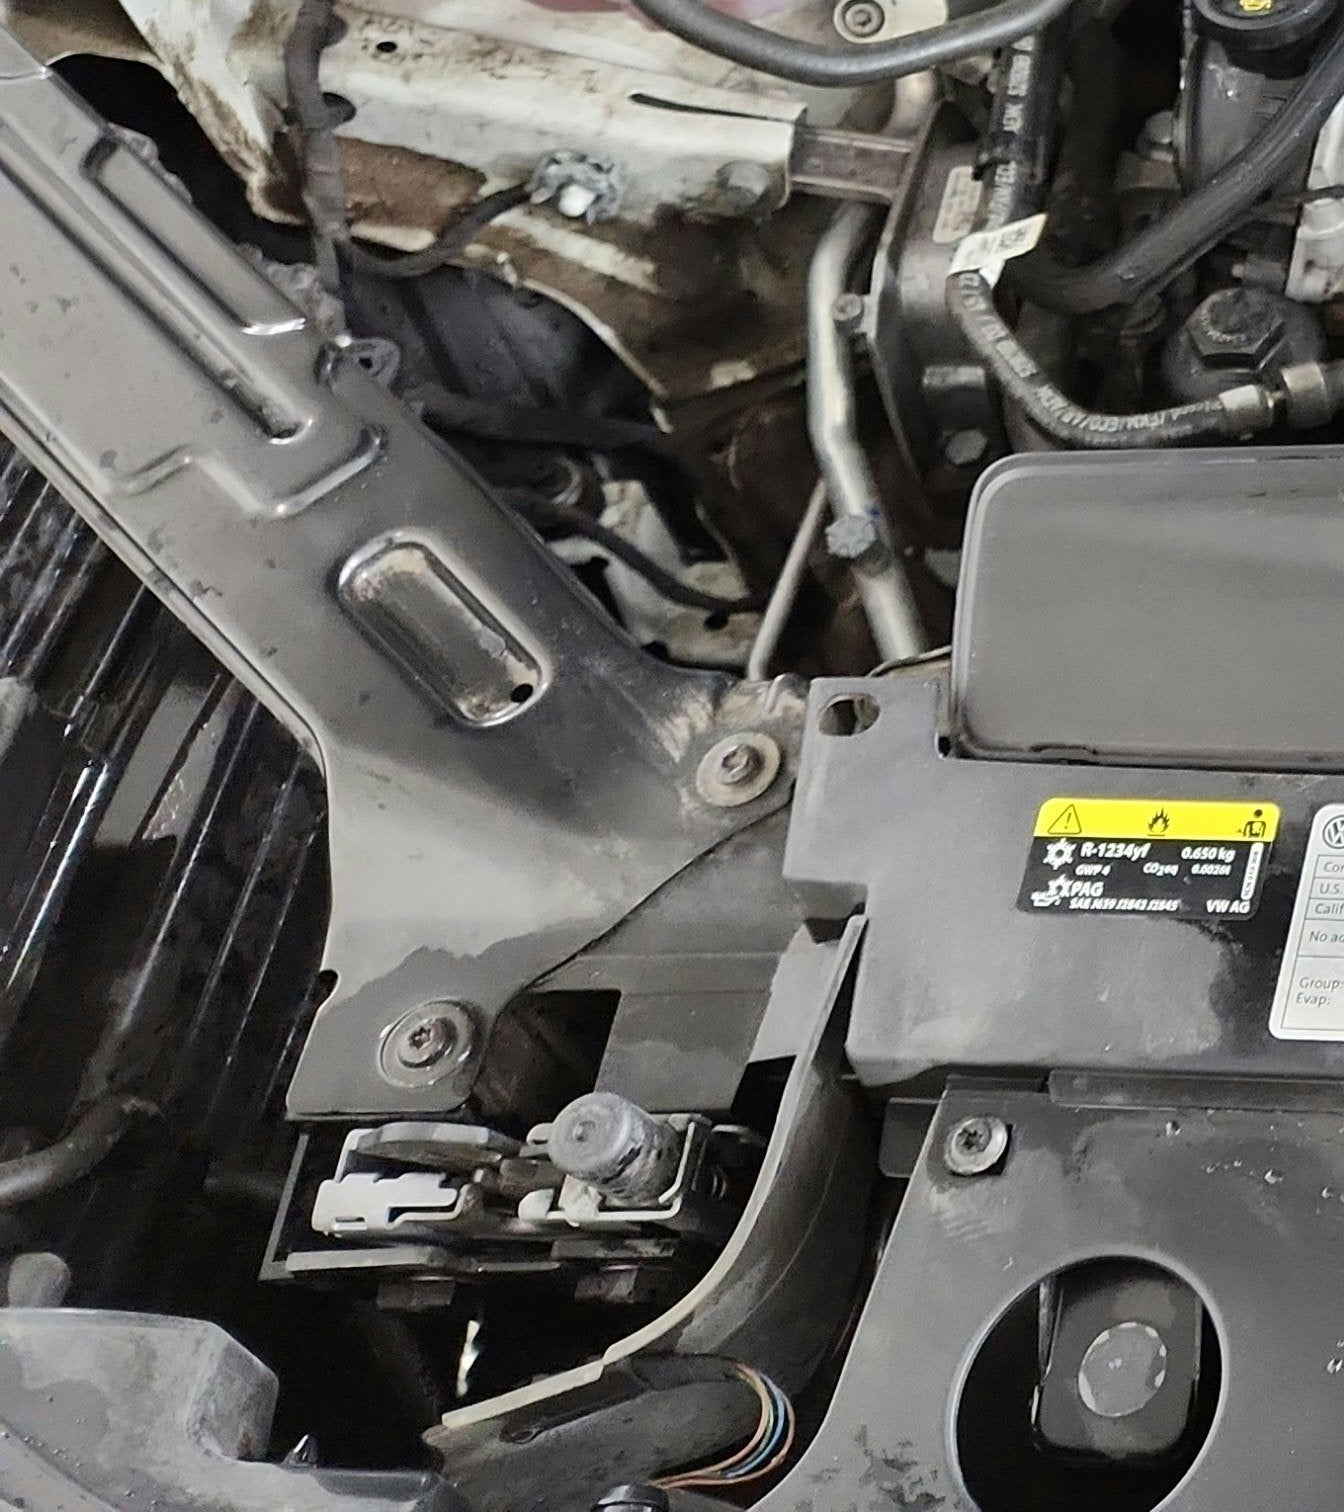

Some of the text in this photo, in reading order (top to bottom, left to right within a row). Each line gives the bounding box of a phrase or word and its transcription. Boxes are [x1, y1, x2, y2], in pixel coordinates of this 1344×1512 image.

[1181, 846, 1236, 863] 0.650 kg
[1076, 864, 1112, 876] GWP 4
[1071, 882, 1104, 896] PAG
[1319, 884, 1343, 895] U.S.
[1069, 898, 1091, 909] SAE
[1207, 899, 1250, 913] VW AG
[1309, 931, 1327, 942] No
[1299, 977, 1344, 991] Group:
[1296, 992, 1330, 1007] Evap:
